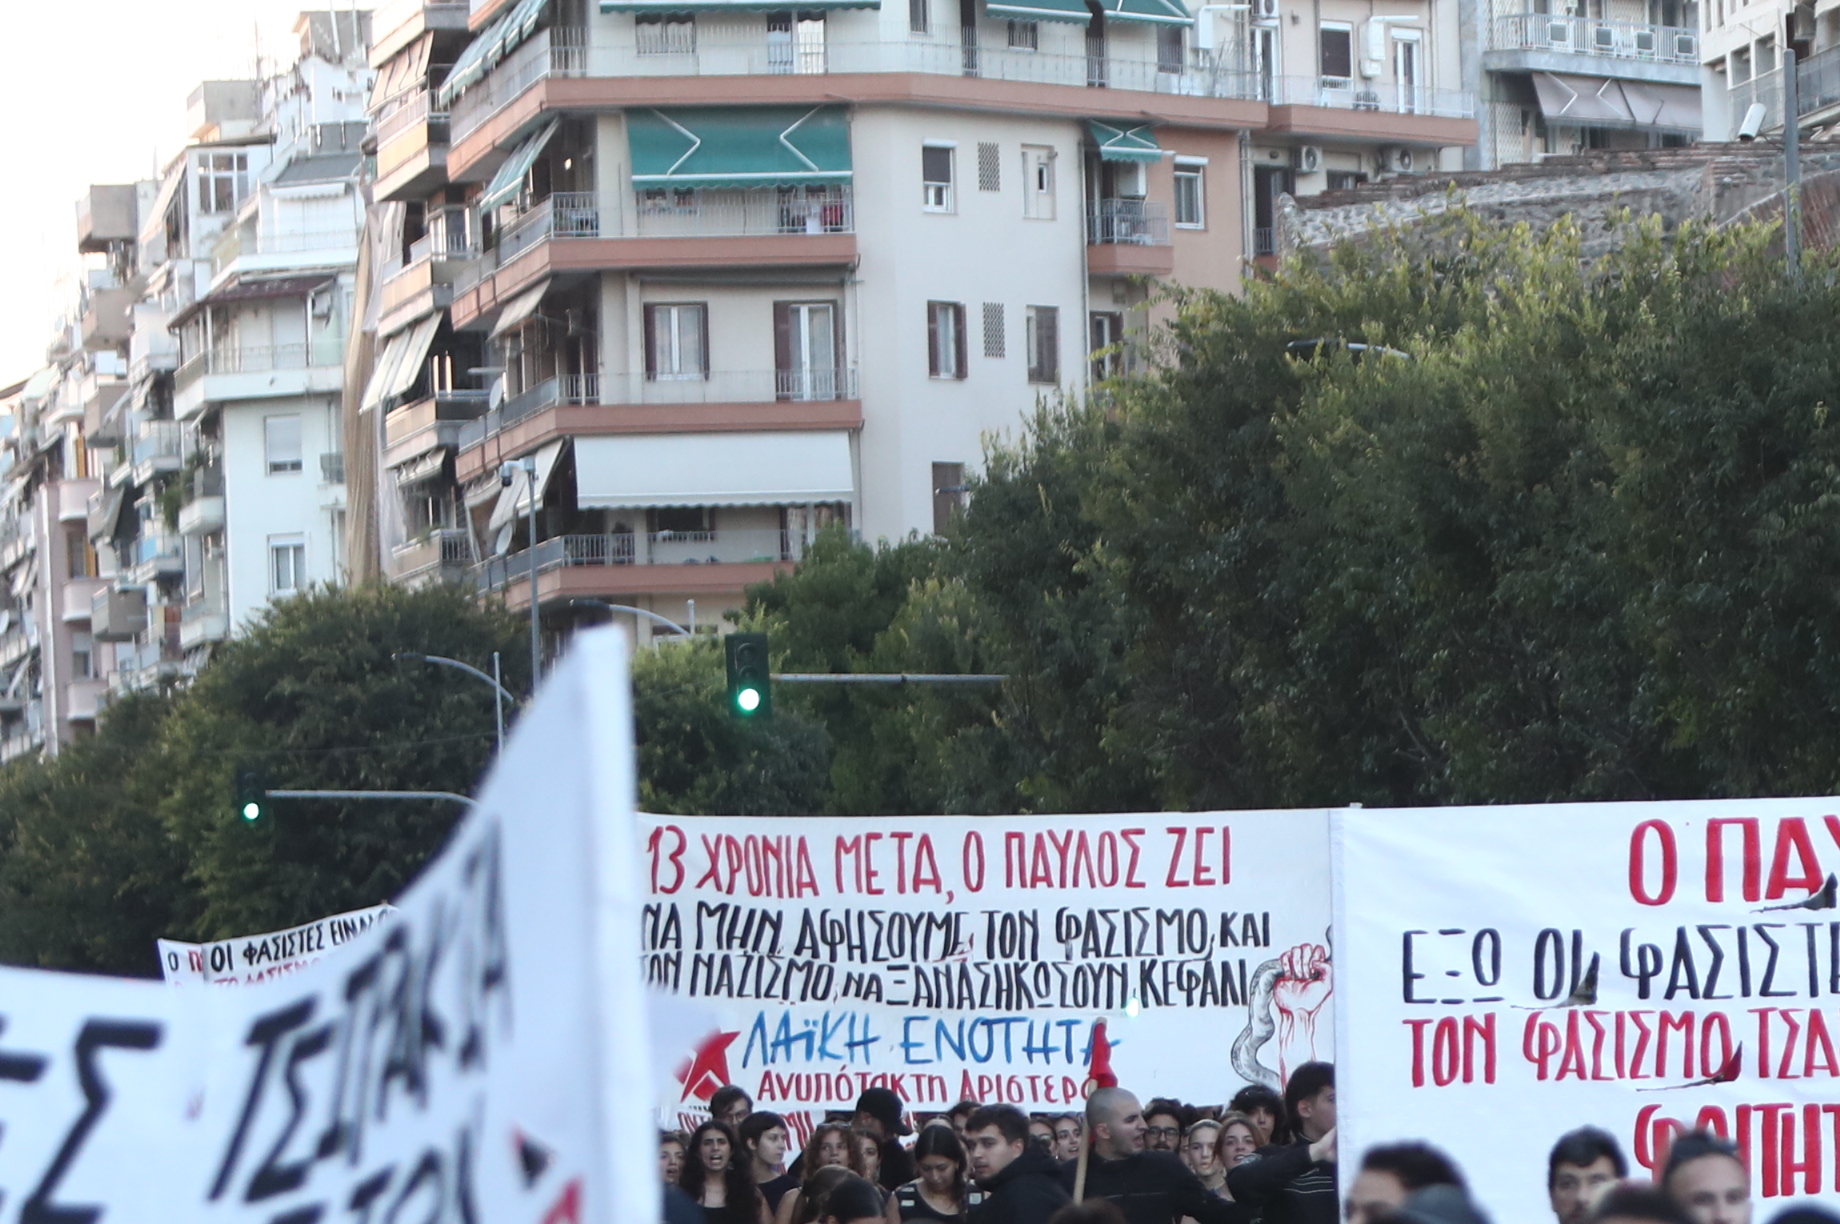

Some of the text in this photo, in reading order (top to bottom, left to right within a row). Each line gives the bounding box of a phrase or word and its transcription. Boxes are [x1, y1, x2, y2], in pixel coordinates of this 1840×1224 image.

[647, 825, 687, 895] 13
[695, 833, 819, 898] ΧΡΟΝΙΑ
[963, 831, 985, 893] Ο
[1005, 828, 1146, 889] ΠΑΥΛΟΣ
[1165, 826, 1231, 888] ΖΕΙ
[1629, 819, 1676, 906] Ο
[211, 943, 233, 972] ΟΙ
[243, 922, 325, 966] ΦΑΣΙΣΤΕΣ
[641, 902, 682, 950] ΝΑ
[696, 900, 783, 954] ΜΗΝ
[794, 908, 970, 962] ΑΦΗΣΟΥΜΕ
[981, 910, 1039, 961] ΤΟΝ
[1220, 911, 1270, 948] ΚΑΙ
[1533, 927, 1583, 1000] ΟΙ
[1402, 1012, 1497, 1087] ΤΟΝ
[1522, 1009, 1733, 1082] ΦΑΣΙΣΜΟ
